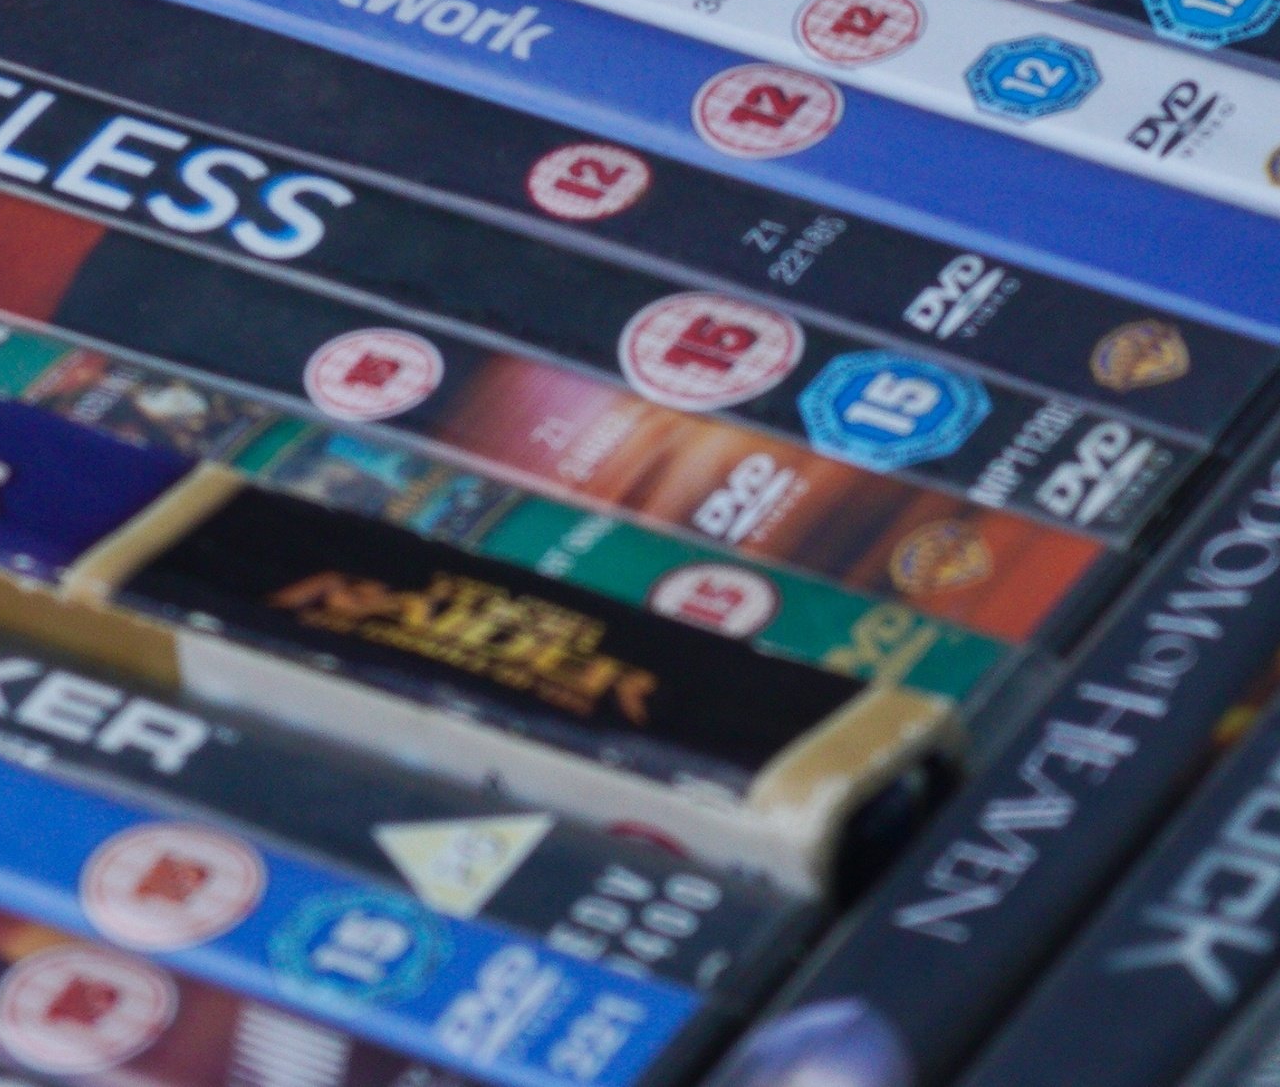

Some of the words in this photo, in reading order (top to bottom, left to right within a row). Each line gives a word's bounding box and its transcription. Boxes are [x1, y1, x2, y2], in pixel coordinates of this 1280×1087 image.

[830, 5, 890, 37] 12
[728, 85, 809, 128] 12
[999, 57, 1066, 98] 12
[1126, 78, 1201, 157] DVD
[553, 156, 627, 200] 12
[901, 253, 986, 334] DVD
[663, 315, 760, 373] 15
[844, 371, 941, 434] 15
[1034, 420, 1133, 518] DVD
